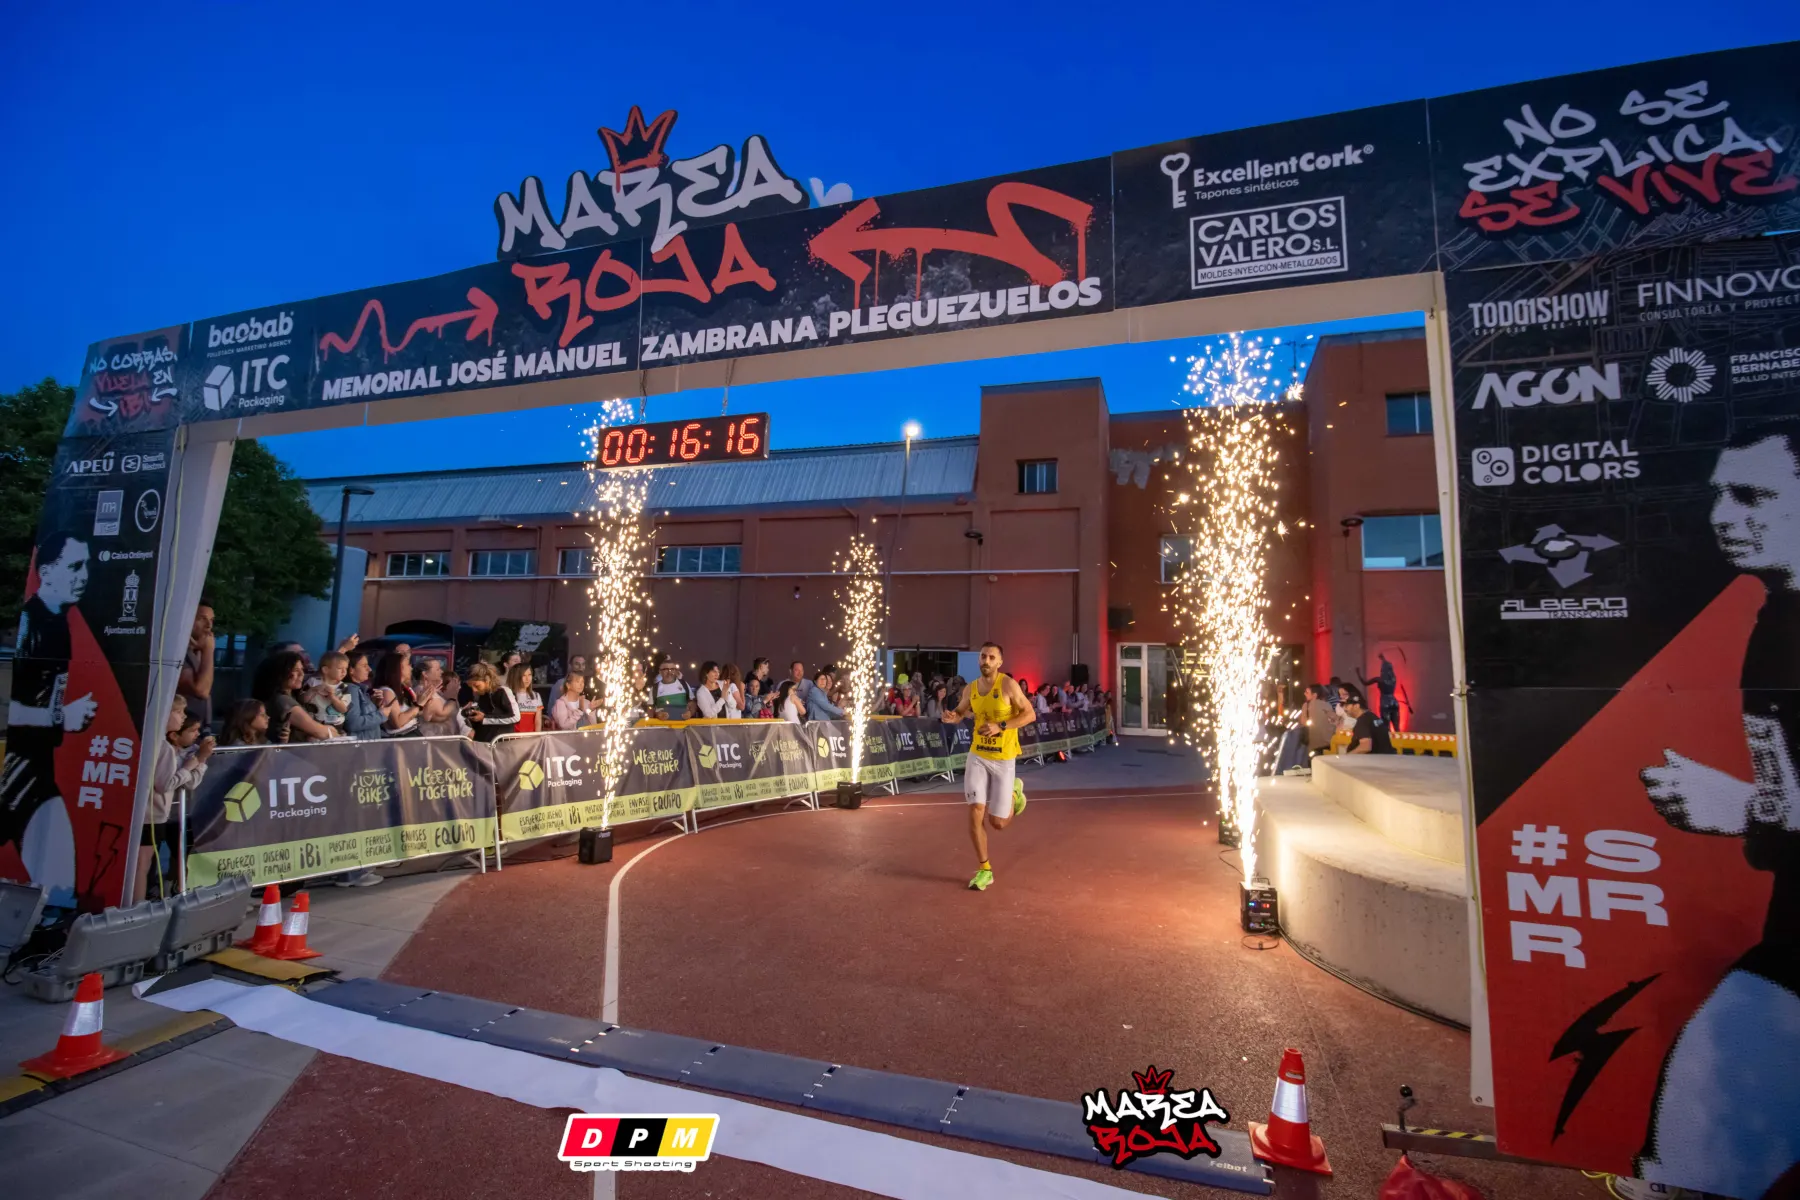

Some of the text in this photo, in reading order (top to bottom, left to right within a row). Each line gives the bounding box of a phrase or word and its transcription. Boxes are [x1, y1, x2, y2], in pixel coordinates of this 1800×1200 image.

[1504, 80, 1730, 148] NO SE
[501, 135, 802, 254] MAREA
[1194, 178, 1299, 201] Tapones sintéticos
[1459, 148, 1798, 232] SE VIVE
[1198, 204, 1337, 243] CARLOS
[1199, 233, 1339, 267] VALERO S.L.
[511, 222, 776, 348] ROJA
[1729, 303, 1736, 312] Y
[322, 277, 1101, 400] MEMORIAL JOSÉ MANUEL ZAMBRANA PLEGUEZUELOS
[240, 354, 290, 395] ITC
[1732, 373, 1770, 384] SALUD
[238, 394, 285, 408] Packaging
[602, 418, 759, 465] 00:16:16
[1522, 439, 1639, 463] DIGITAL
[1522, 460, 1641, 485] COLORS
[89, 735, 134, 760] #S
[829, 736, 845, 751] ITC
[901, 732, 913, 746] ITC
[716, 743, 741, 761] ITC
[81, 760, 131, 787] MR
[545, 755, 582, 779] ITC
[642, 759, 679, 776] TOGETHER
[269, 775, 327, 808] ITC
[418, 781, 474, 801] TOGETHER
[547, 778, 582, 788] Packaging
[78, 786, 104, 810] R
[269, 805, 327, 820] Packaging
[1511, 824, 1661, 873] #S
[217, 854, 255, 871] ESFUERZO
[1506, 871, 1669, 926] MR
[1510, 920, 1586, 969] R
